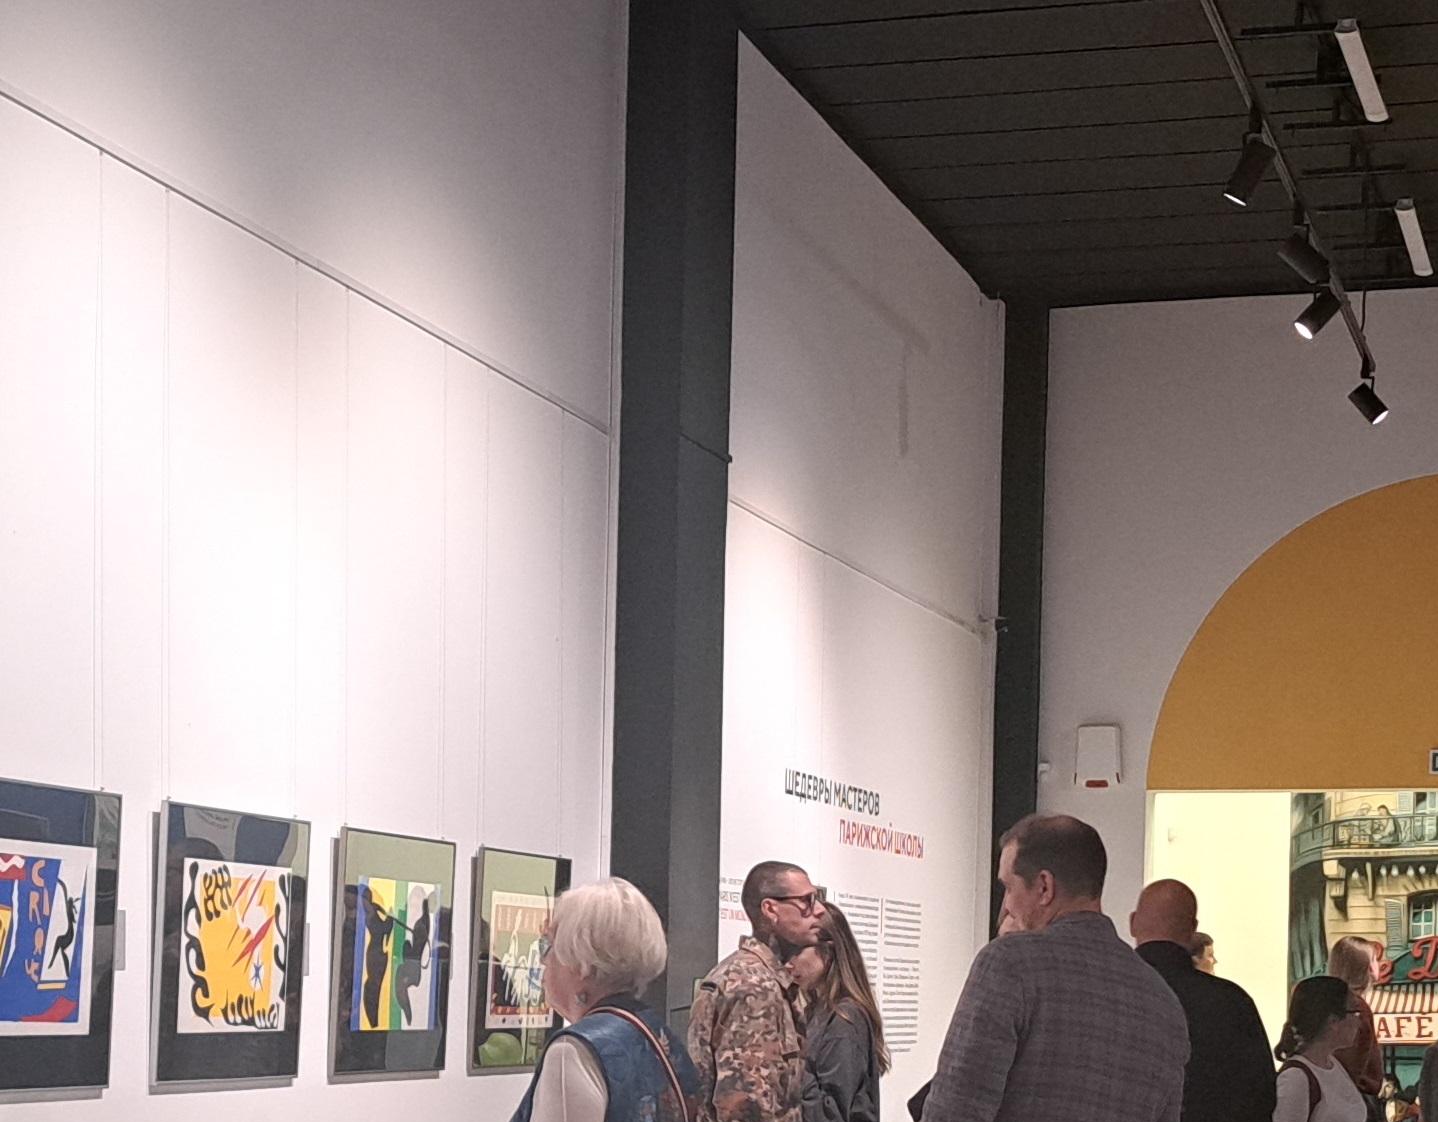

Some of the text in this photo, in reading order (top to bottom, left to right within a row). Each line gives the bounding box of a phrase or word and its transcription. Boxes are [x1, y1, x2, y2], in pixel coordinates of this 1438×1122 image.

[784, 767, 880, 817] ШЕДЕВРЫ МАСТЕРОВ
[838, 818, 924, 859] ПАРИЖСКОЙ ШКОЛЫ
